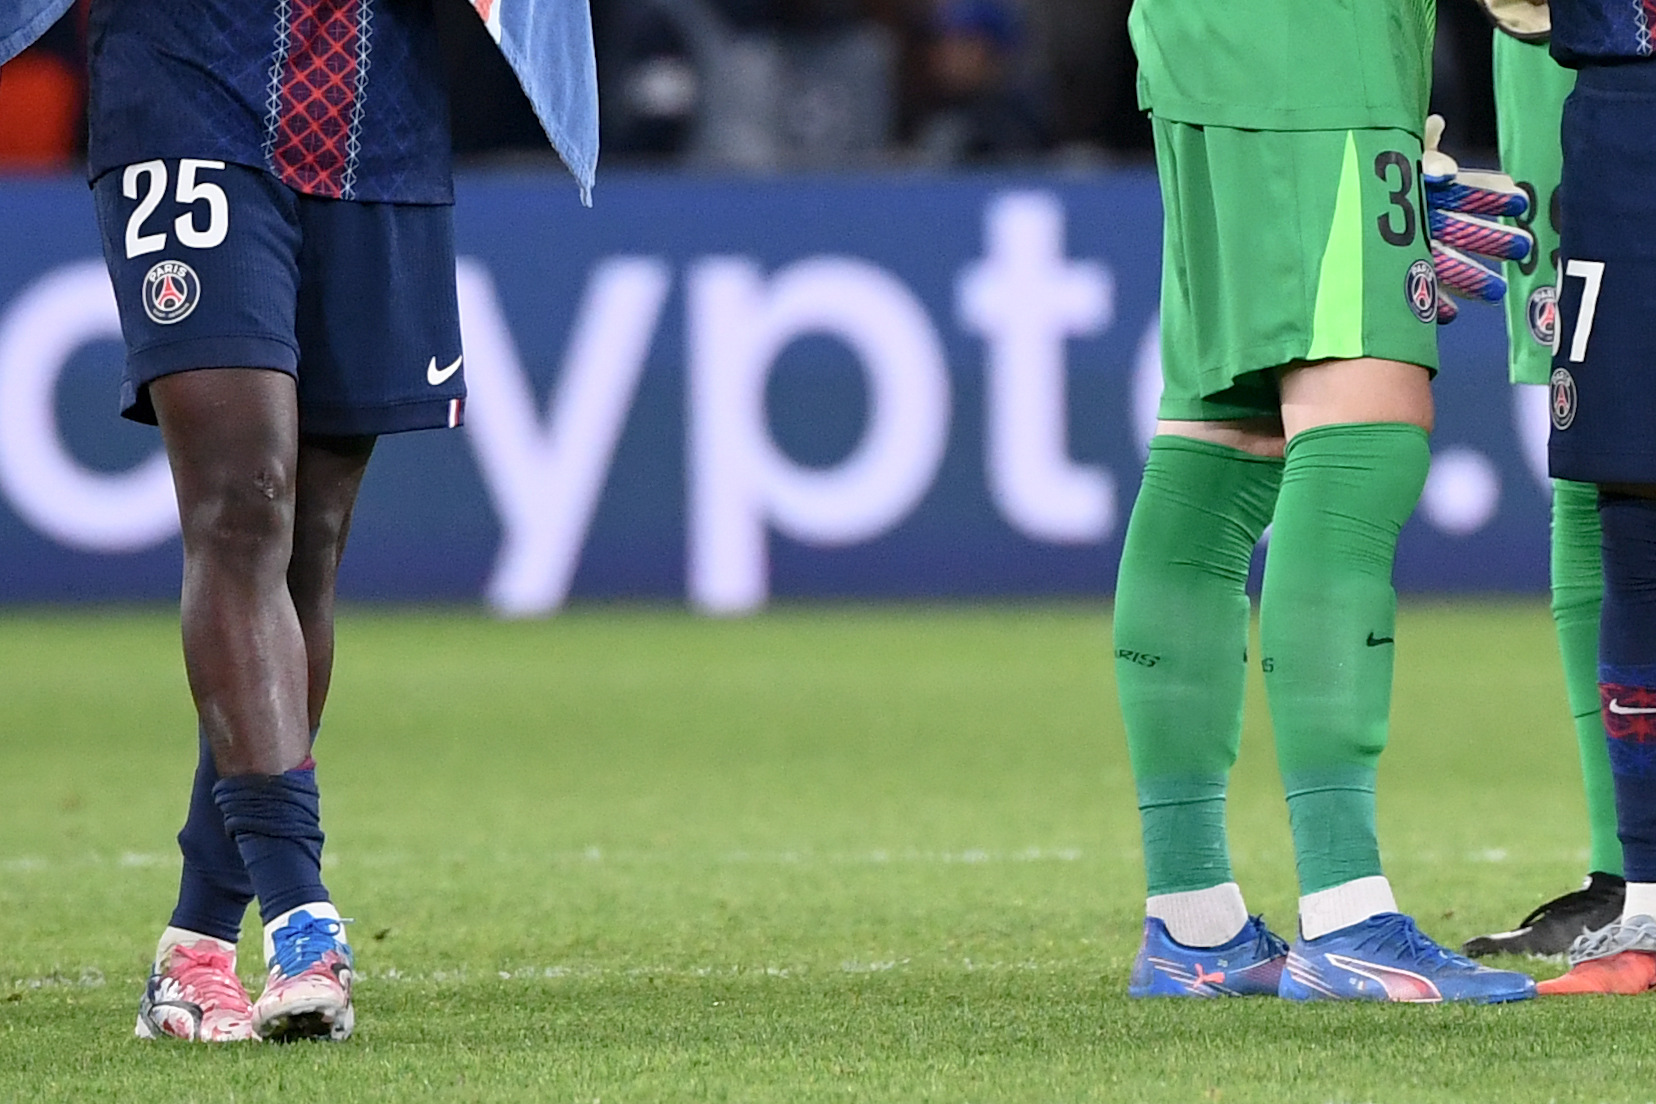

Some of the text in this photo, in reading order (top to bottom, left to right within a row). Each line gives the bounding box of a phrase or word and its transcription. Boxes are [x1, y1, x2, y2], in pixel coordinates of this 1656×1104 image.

[123, 158, 229, 259] 25
[148, 264, 188, 282] PARIS
[1551, 257, 1605, 362] 7
